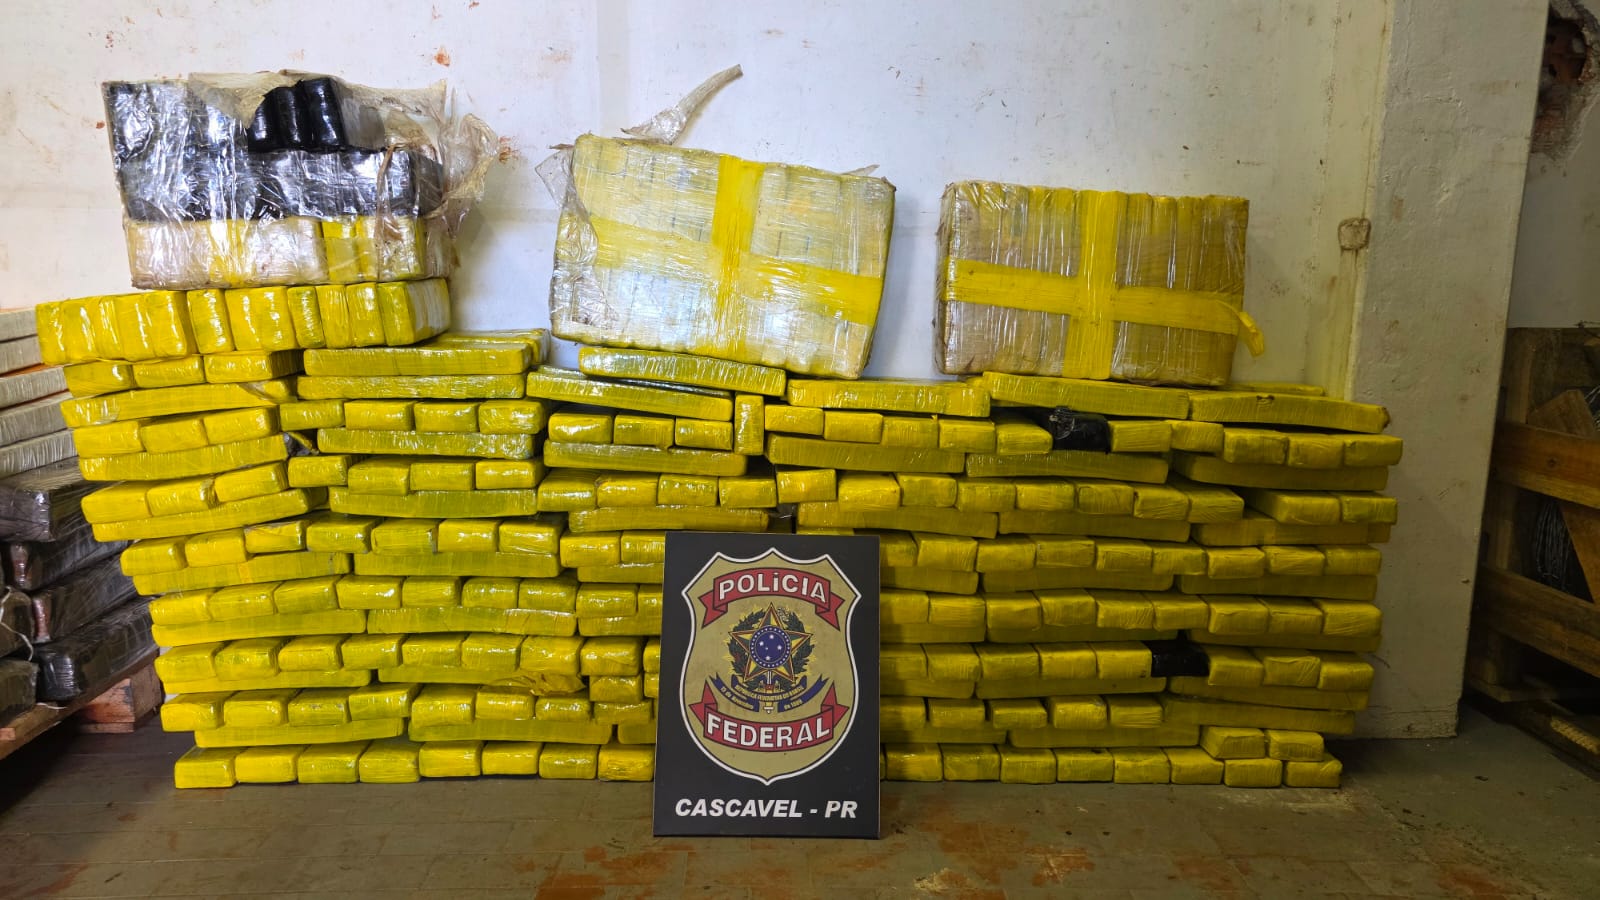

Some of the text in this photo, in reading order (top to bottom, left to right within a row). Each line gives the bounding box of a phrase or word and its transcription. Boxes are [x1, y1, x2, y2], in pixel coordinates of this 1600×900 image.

[707, 713, 830, 748] FEDERAL
[675, 798, 803, 818] CASCAVEL
[824, 800, 858, 818] PR
